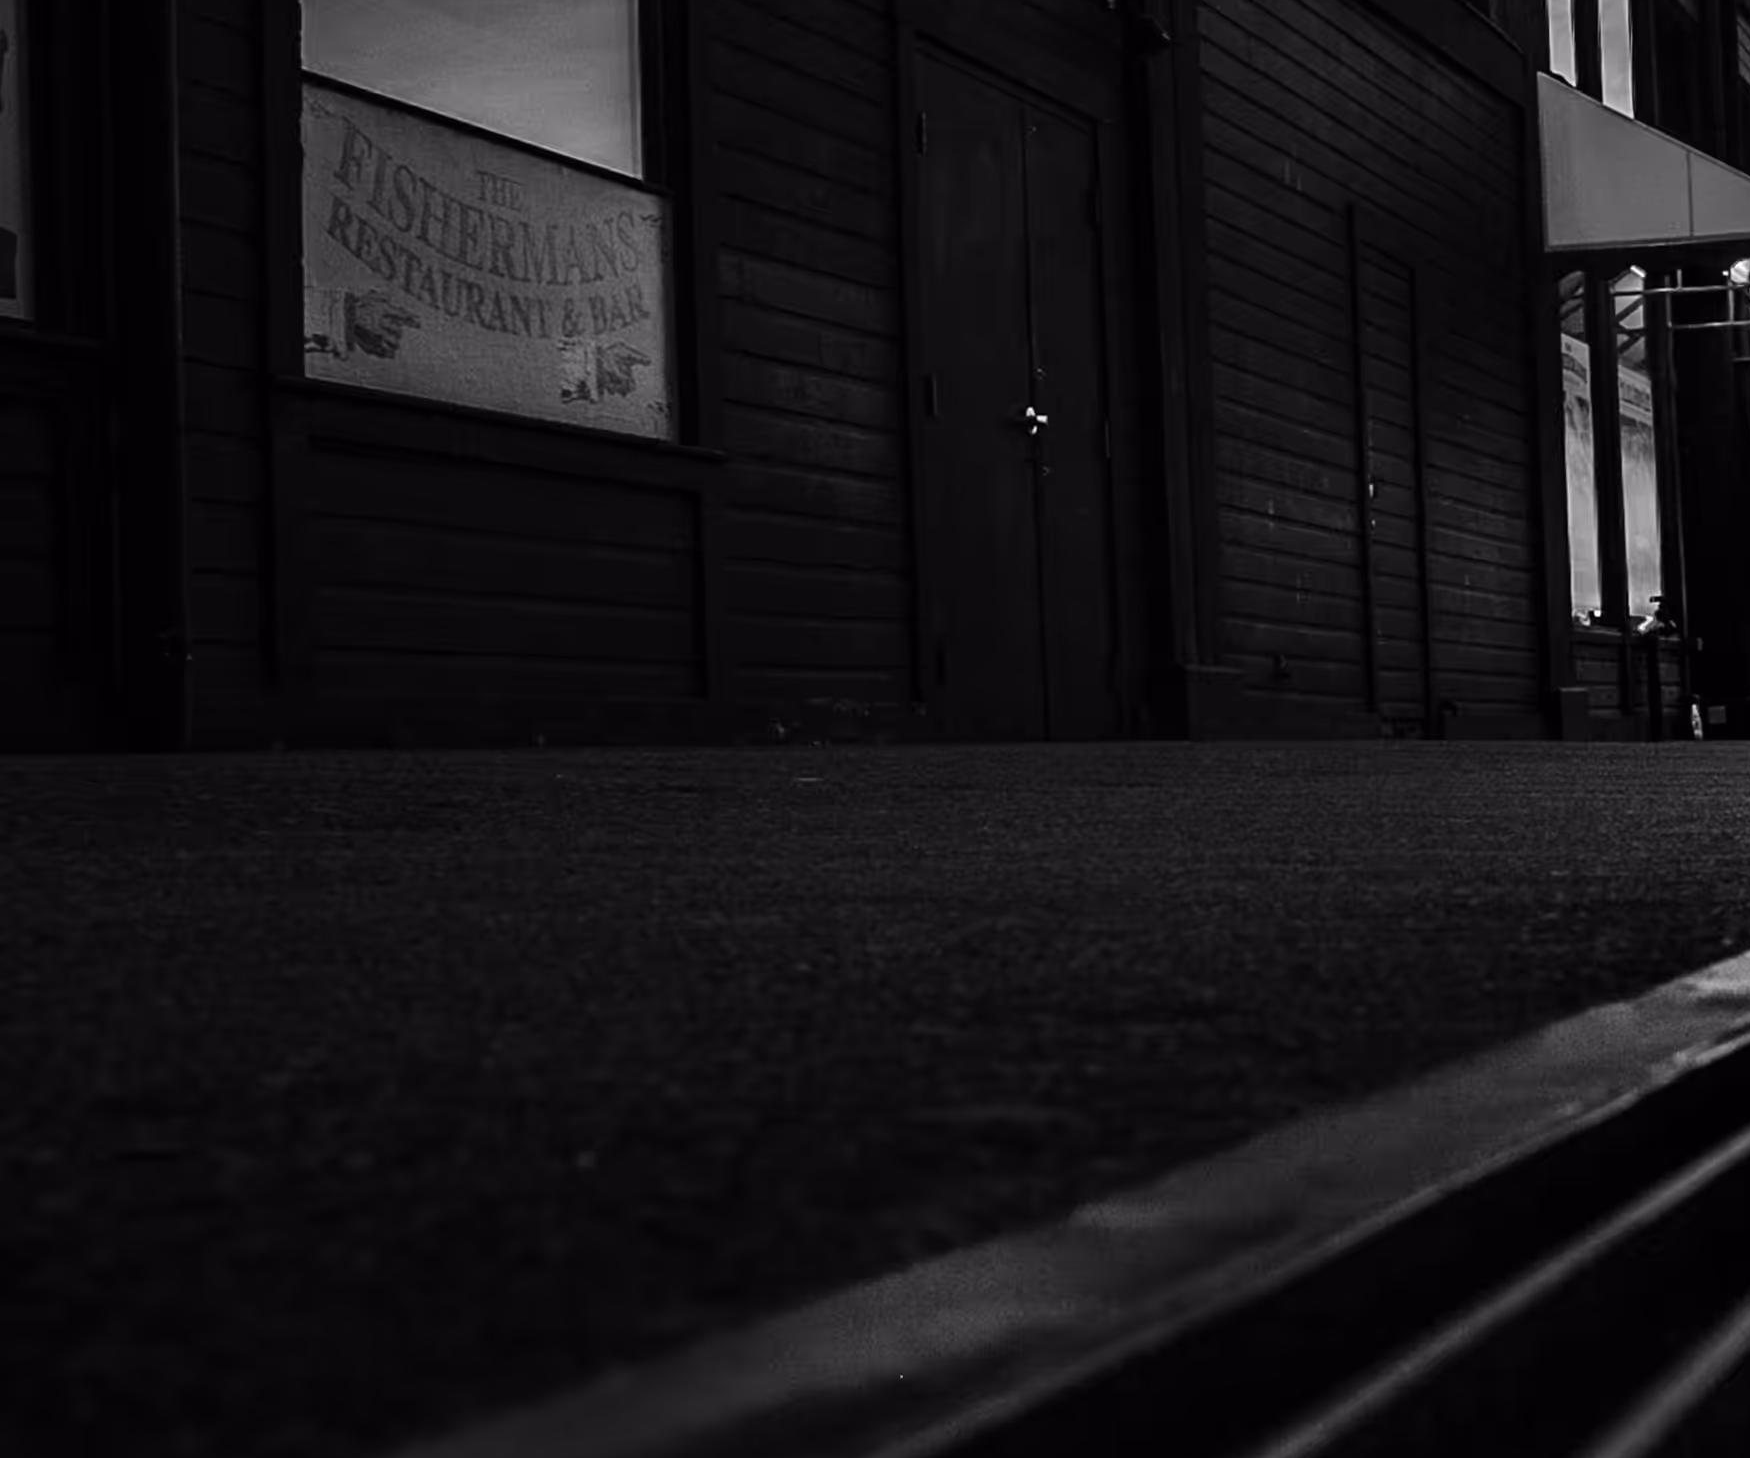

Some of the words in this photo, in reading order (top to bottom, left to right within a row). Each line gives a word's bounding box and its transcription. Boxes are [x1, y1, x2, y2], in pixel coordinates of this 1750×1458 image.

[476, 170, 522, 212] THE
[327, 196, 550, 338] RESTAURANT
[562, 297, 586, 338] &
[590, 283, 649, 336] BAR
